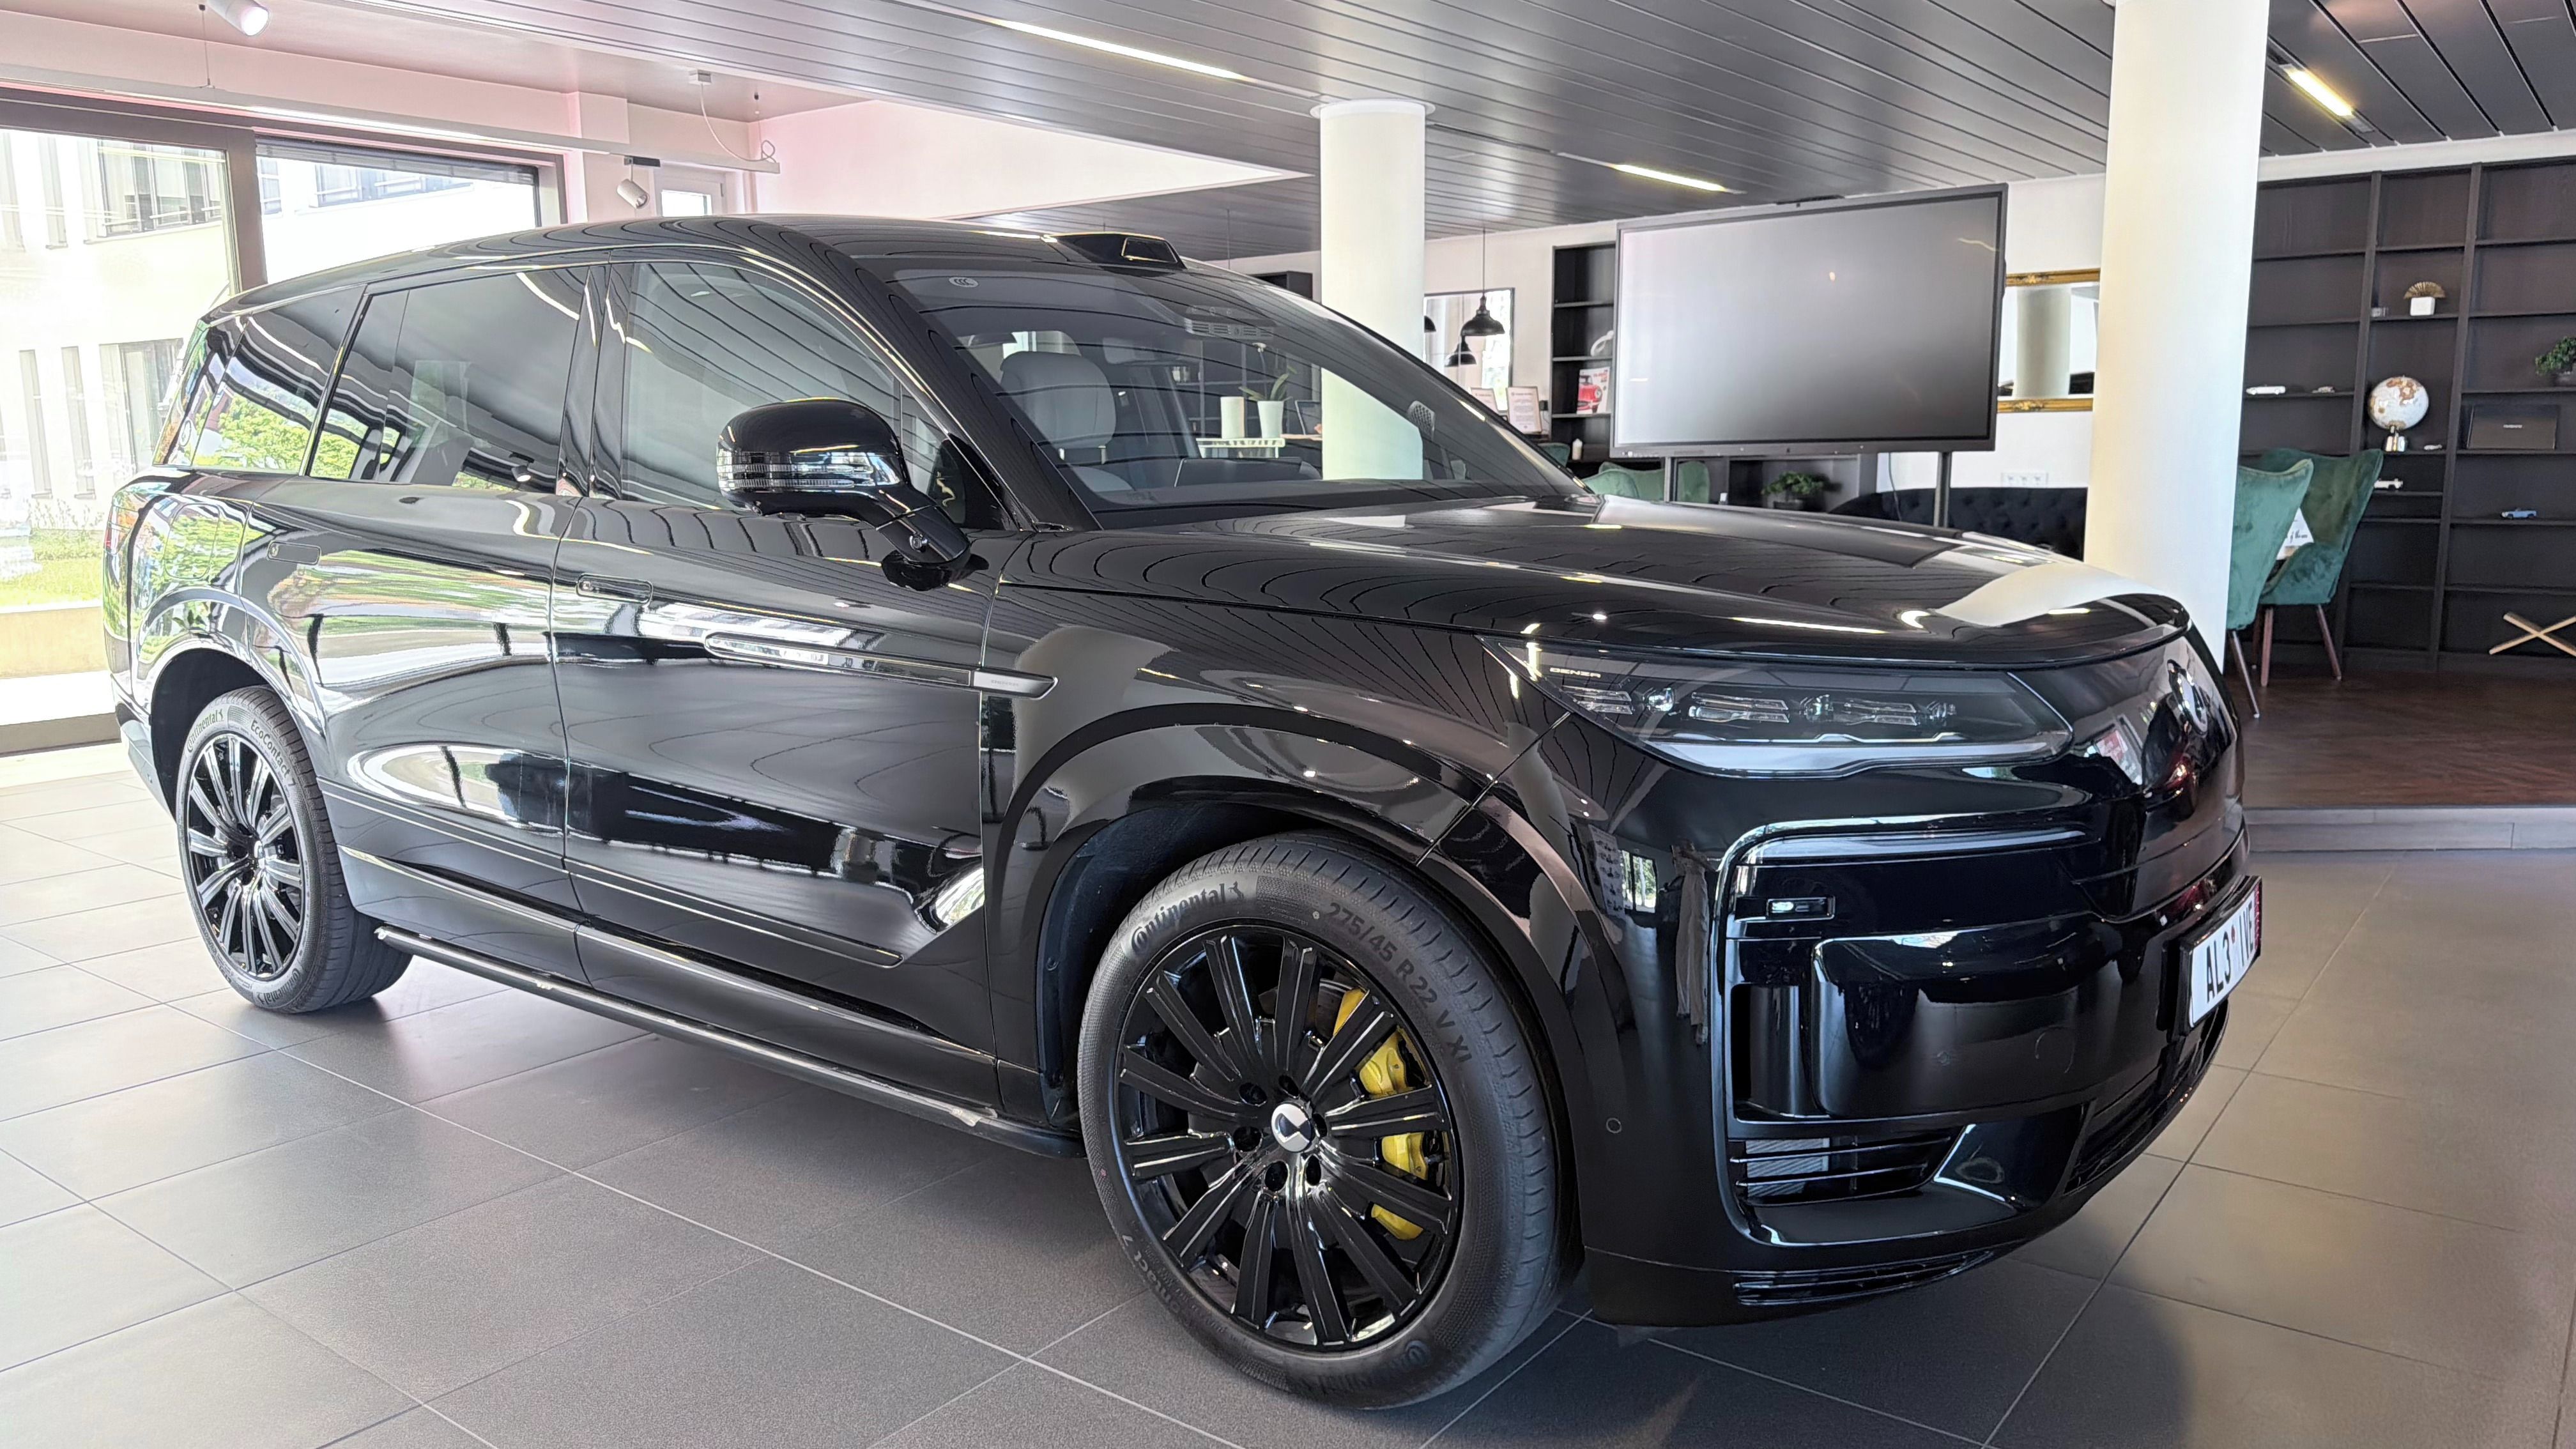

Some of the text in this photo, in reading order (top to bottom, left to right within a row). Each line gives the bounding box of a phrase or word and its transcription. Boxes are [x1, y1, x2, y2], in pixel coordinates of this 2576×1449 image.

[187, 709, 218, 753] Continental
[250, 719, 296, 786] EcoContact 7
[1131, 883, 1226, 953] Continental
[1326, 901, 1398, 962] 275/45
[1395, 958, 1415, 982] R
[1409, 976, 1438, 1009] 22
[1438, 1009, 1456, 1029] V
